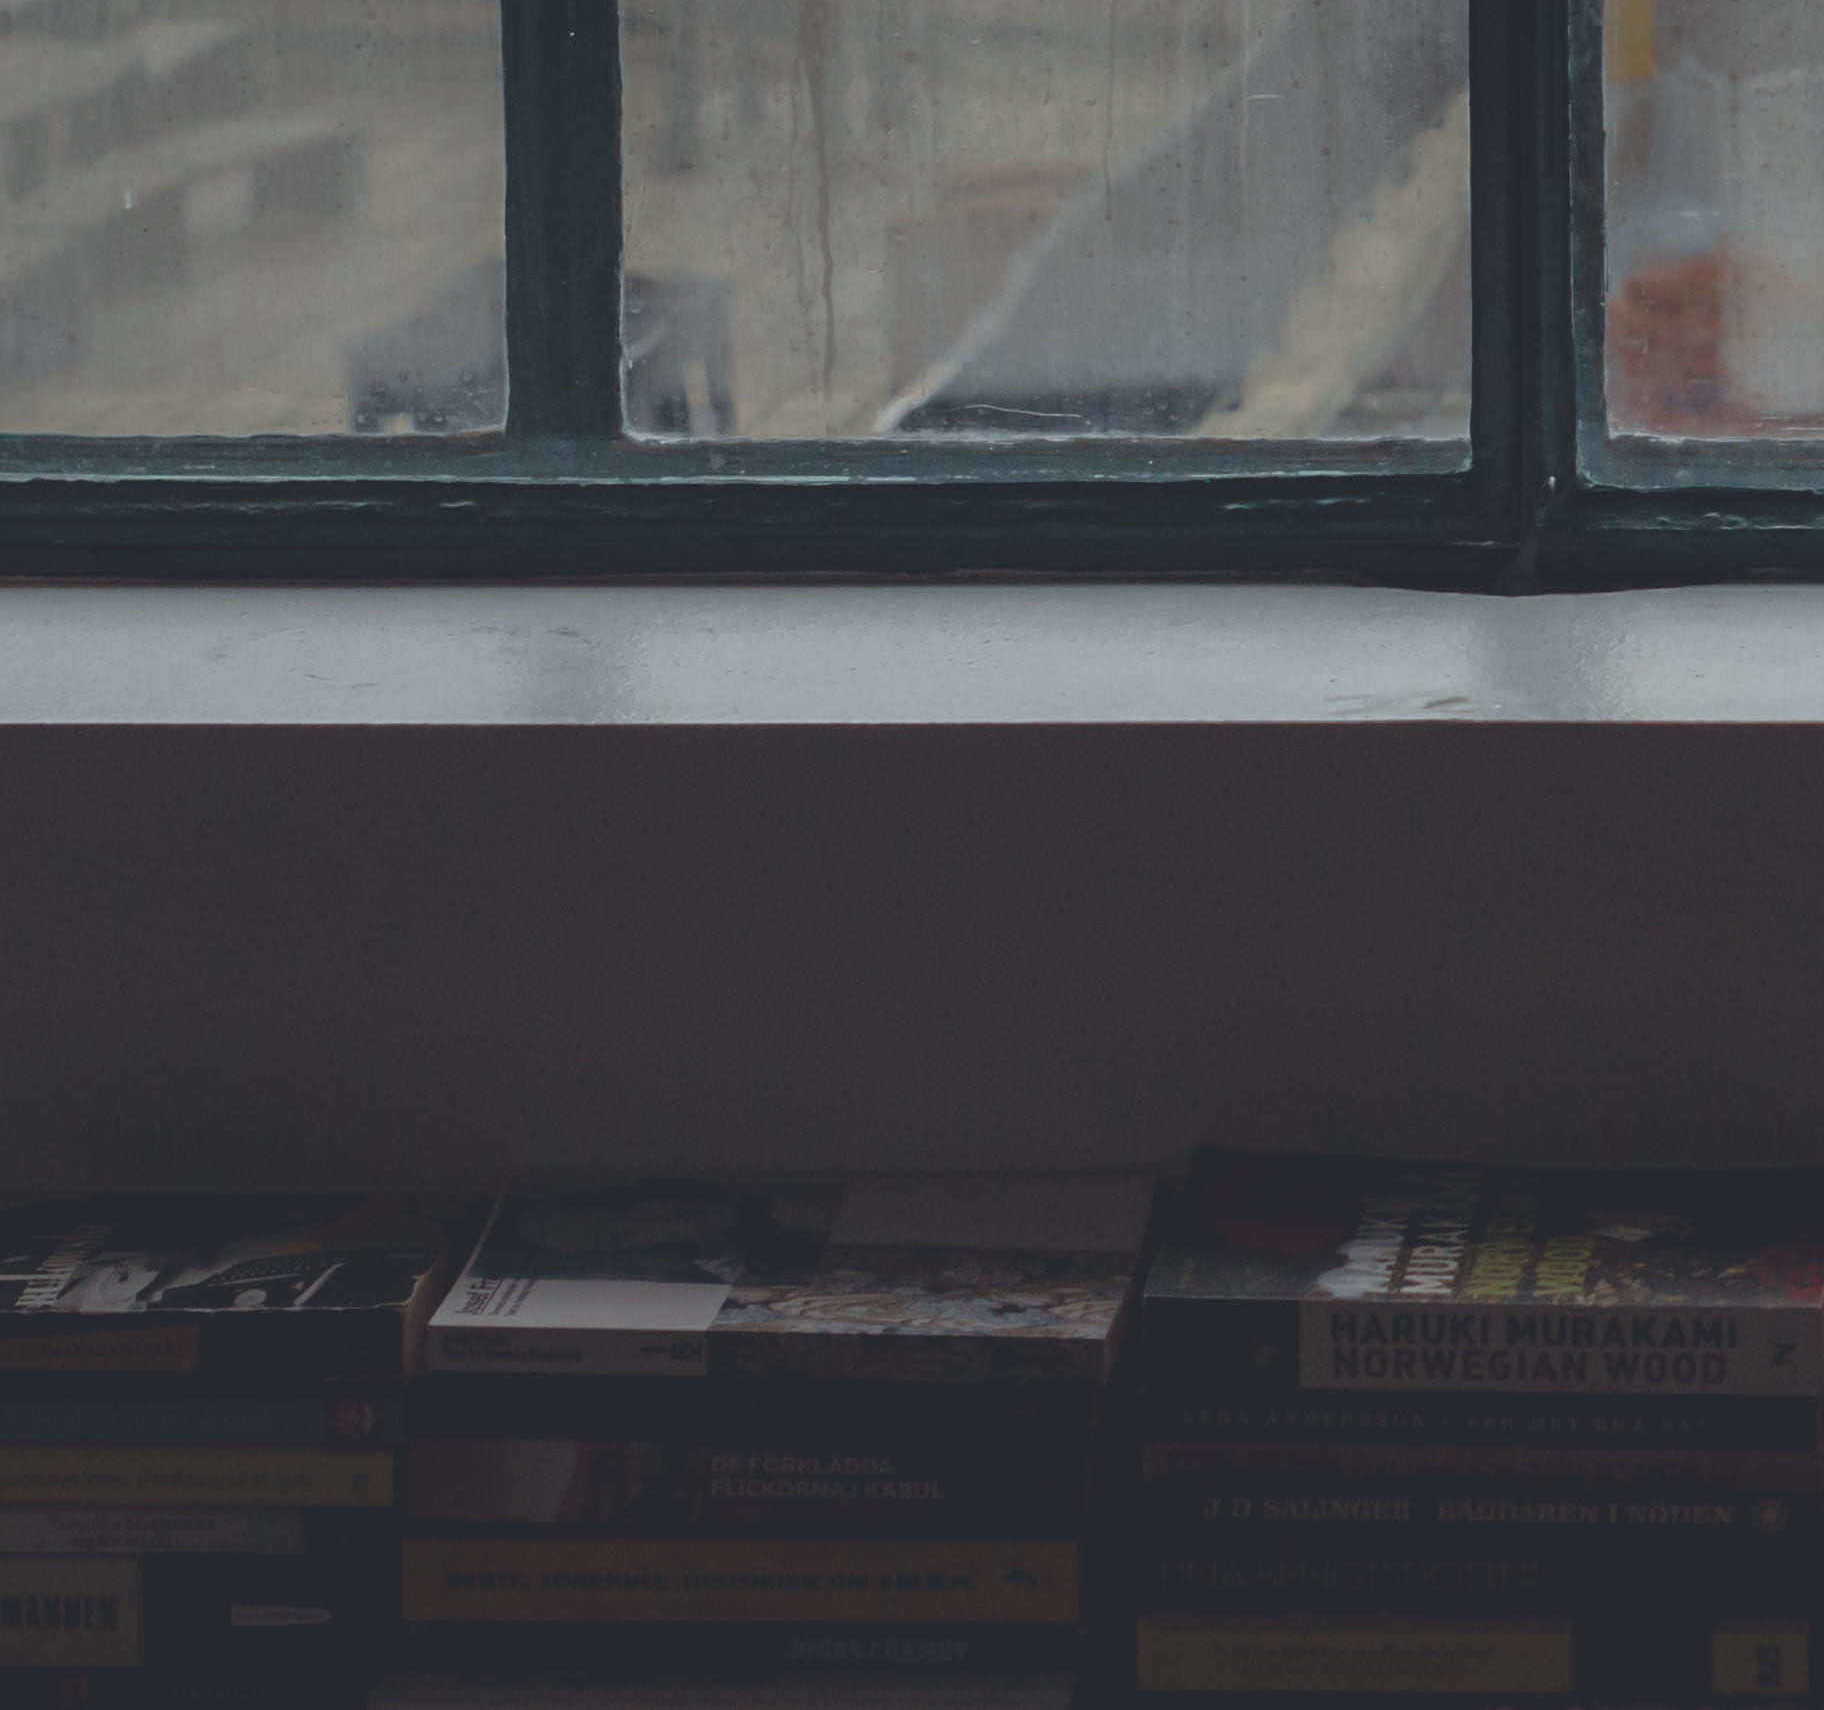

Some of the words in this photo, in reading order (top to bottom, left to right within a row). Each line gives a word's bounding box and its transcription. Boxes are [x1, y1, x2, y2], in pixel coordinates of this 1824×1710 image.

[1331, 1313, 1490, 1346] HARUKI
[1506, 1315, 1737, 1349] MURAKAMI
[1332, 1348, 1588, 1382] NORWEGIAN
[1604, 1351, 1728, 1385] WOOD
[710, 1455, 741, 1475] DE
[710, 1479, 846, 1498] FLICKORNA
[862, 1480, 944, 1501] KABUL
[1262, 1497, 1412, 1521] SALINGER
[2, 1596, 117, 1628] MANNEN
